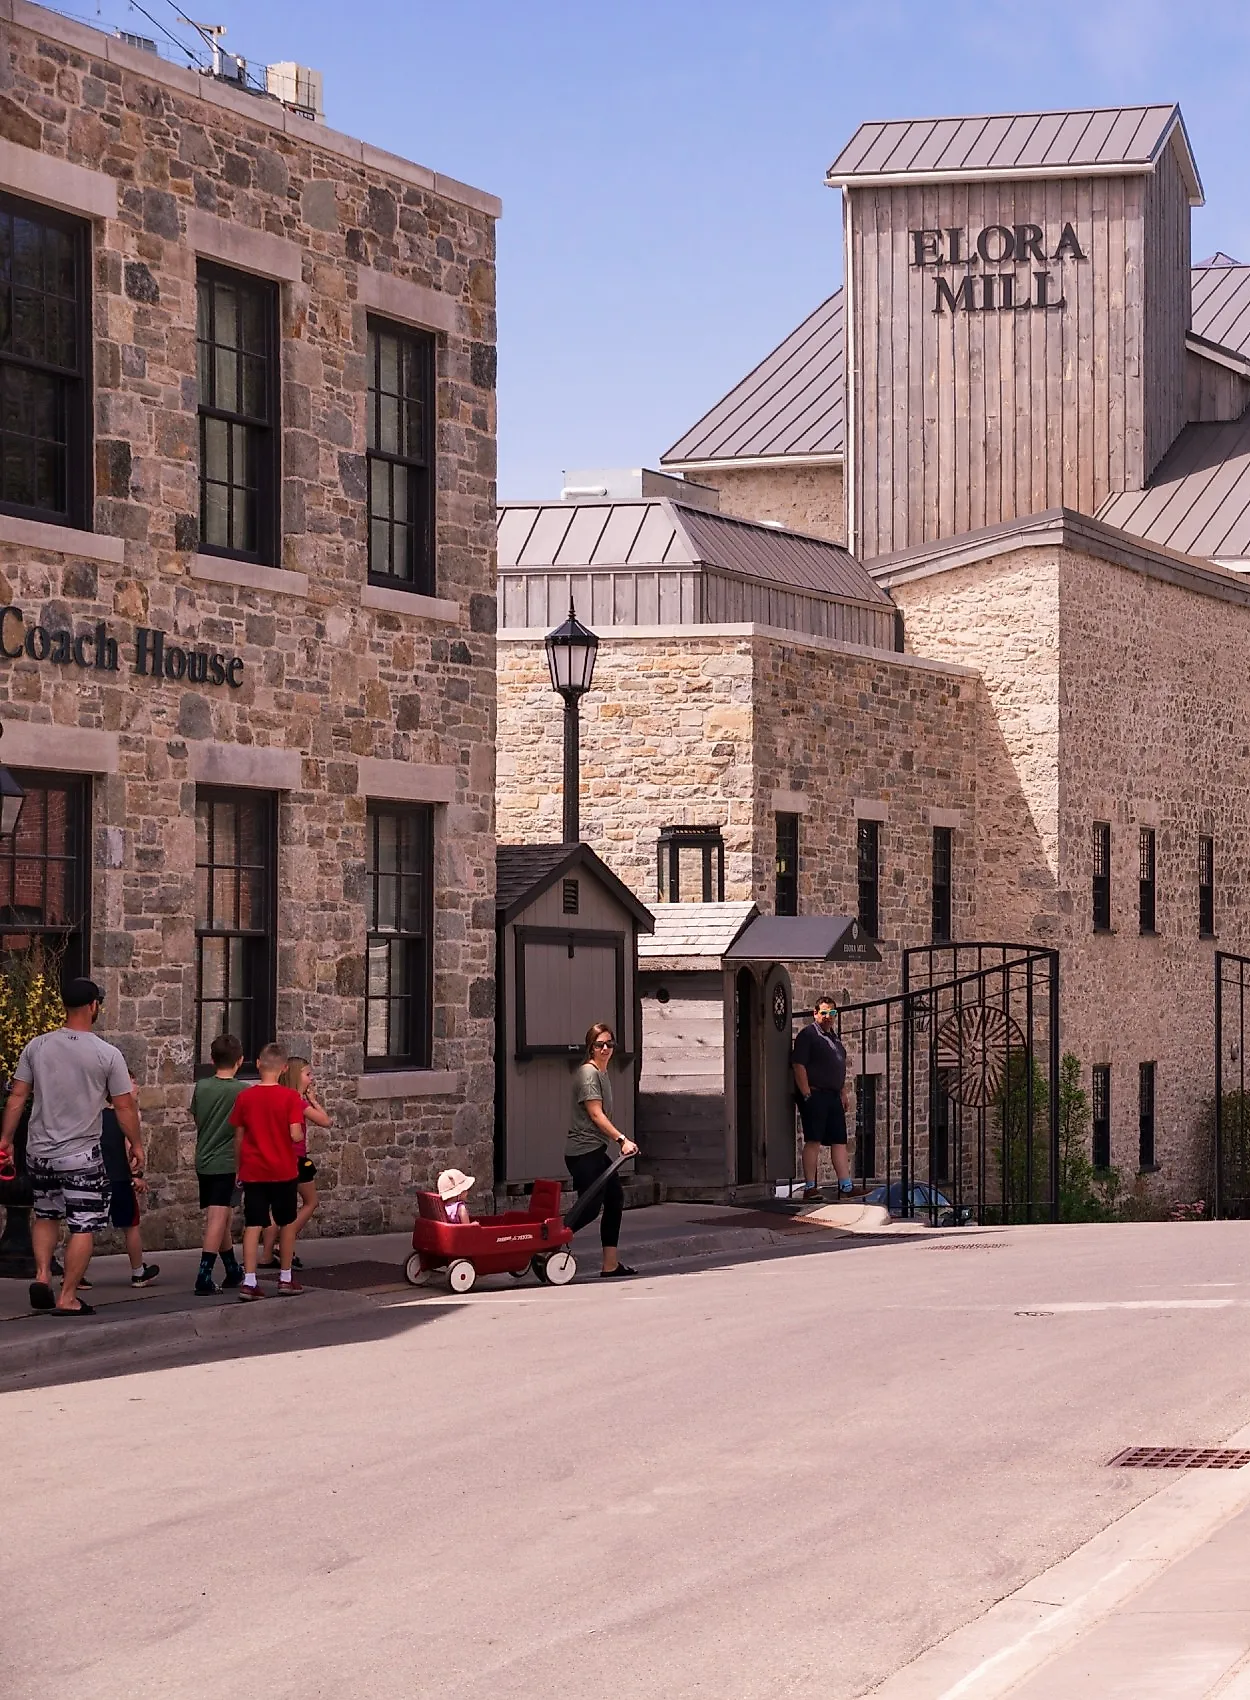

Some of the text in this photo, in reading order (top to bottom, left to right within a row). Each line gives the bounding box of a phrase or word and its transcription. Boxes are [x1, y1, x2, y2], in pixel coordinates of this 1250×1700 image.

[909, 222, 1087, 267] ELORA
[931, 271, 1066, 313] MILL
[0, 605, 245, 689] Coach House
